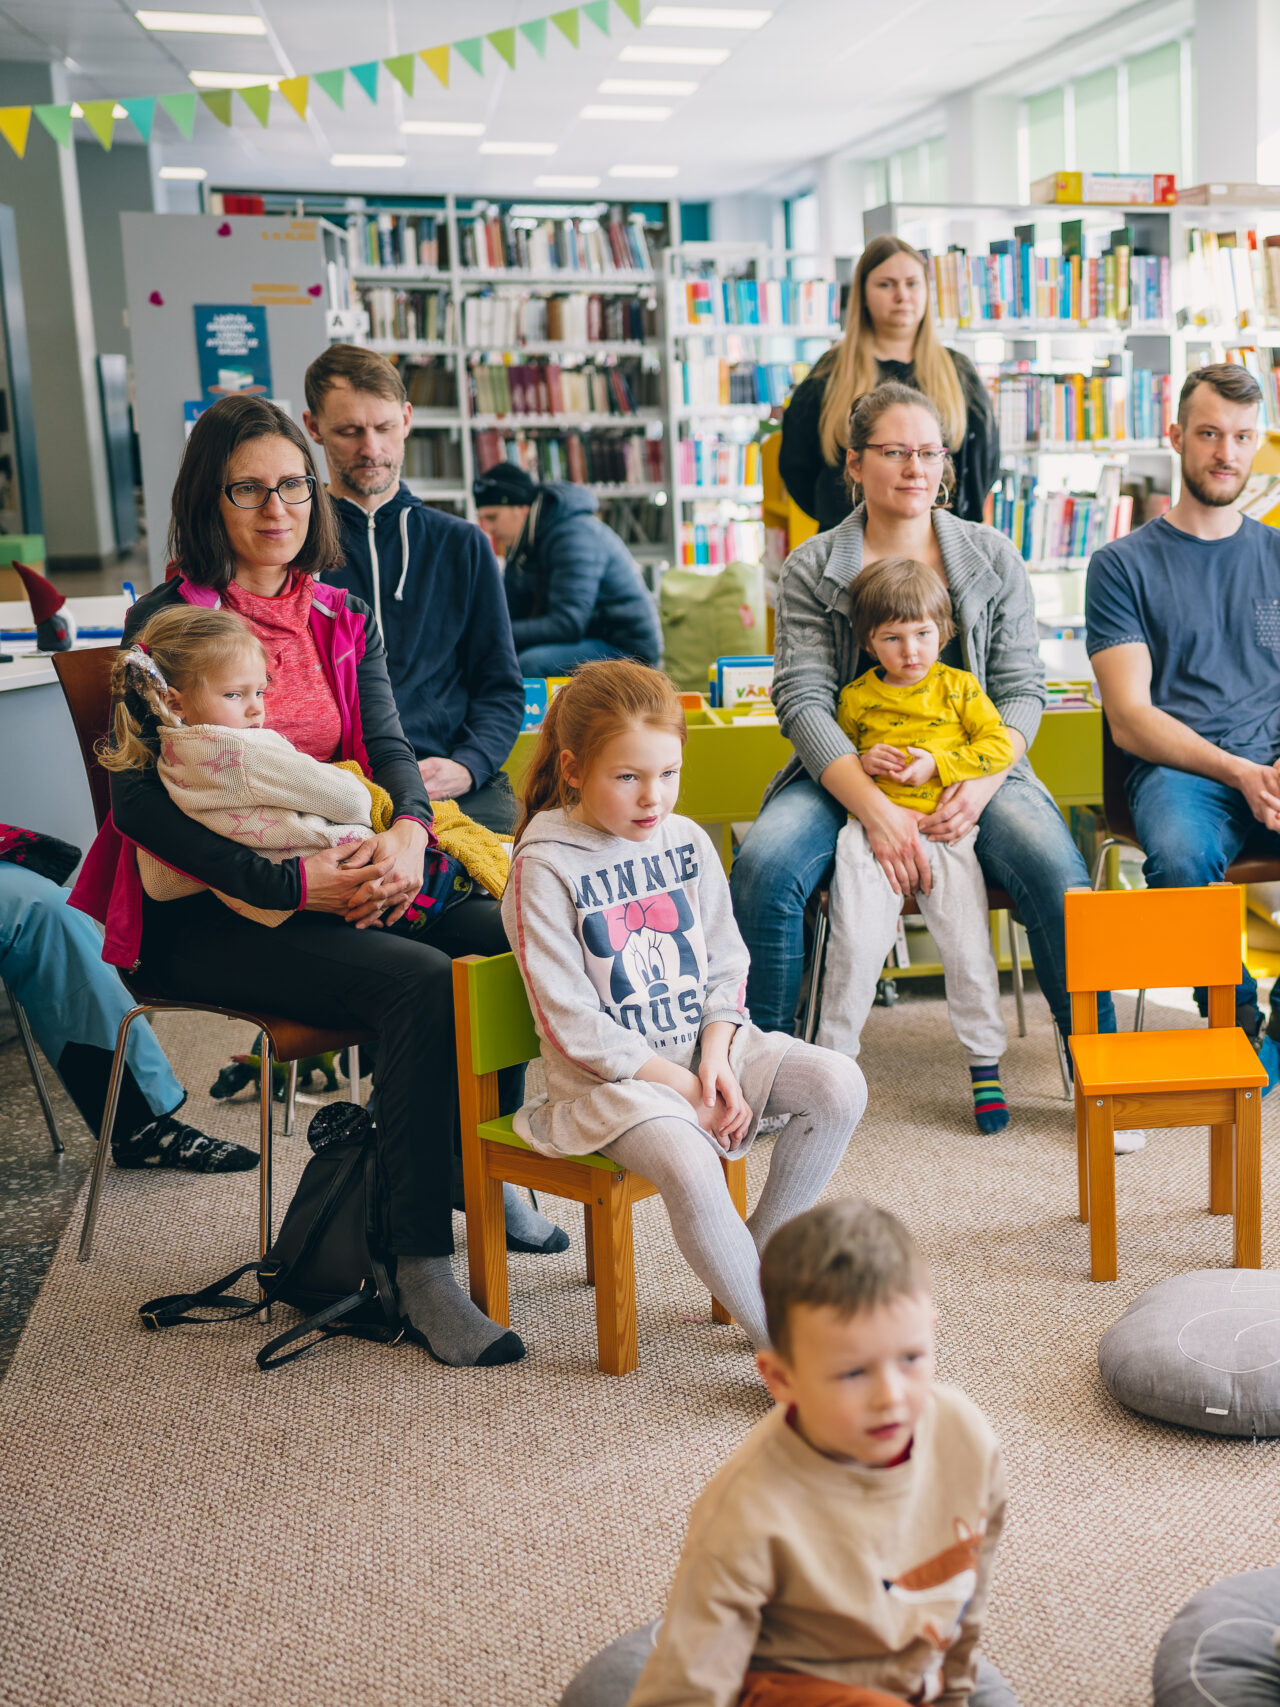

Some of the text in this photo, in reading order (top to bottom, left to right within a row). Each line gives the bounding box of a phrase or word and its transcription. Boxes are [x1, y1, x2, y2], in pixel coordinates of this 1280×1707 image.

[568, 843, 700, 909] MINNIE
[604, 984, 707, 1036] OUS
[654, 1039, 667, 1049] IN
